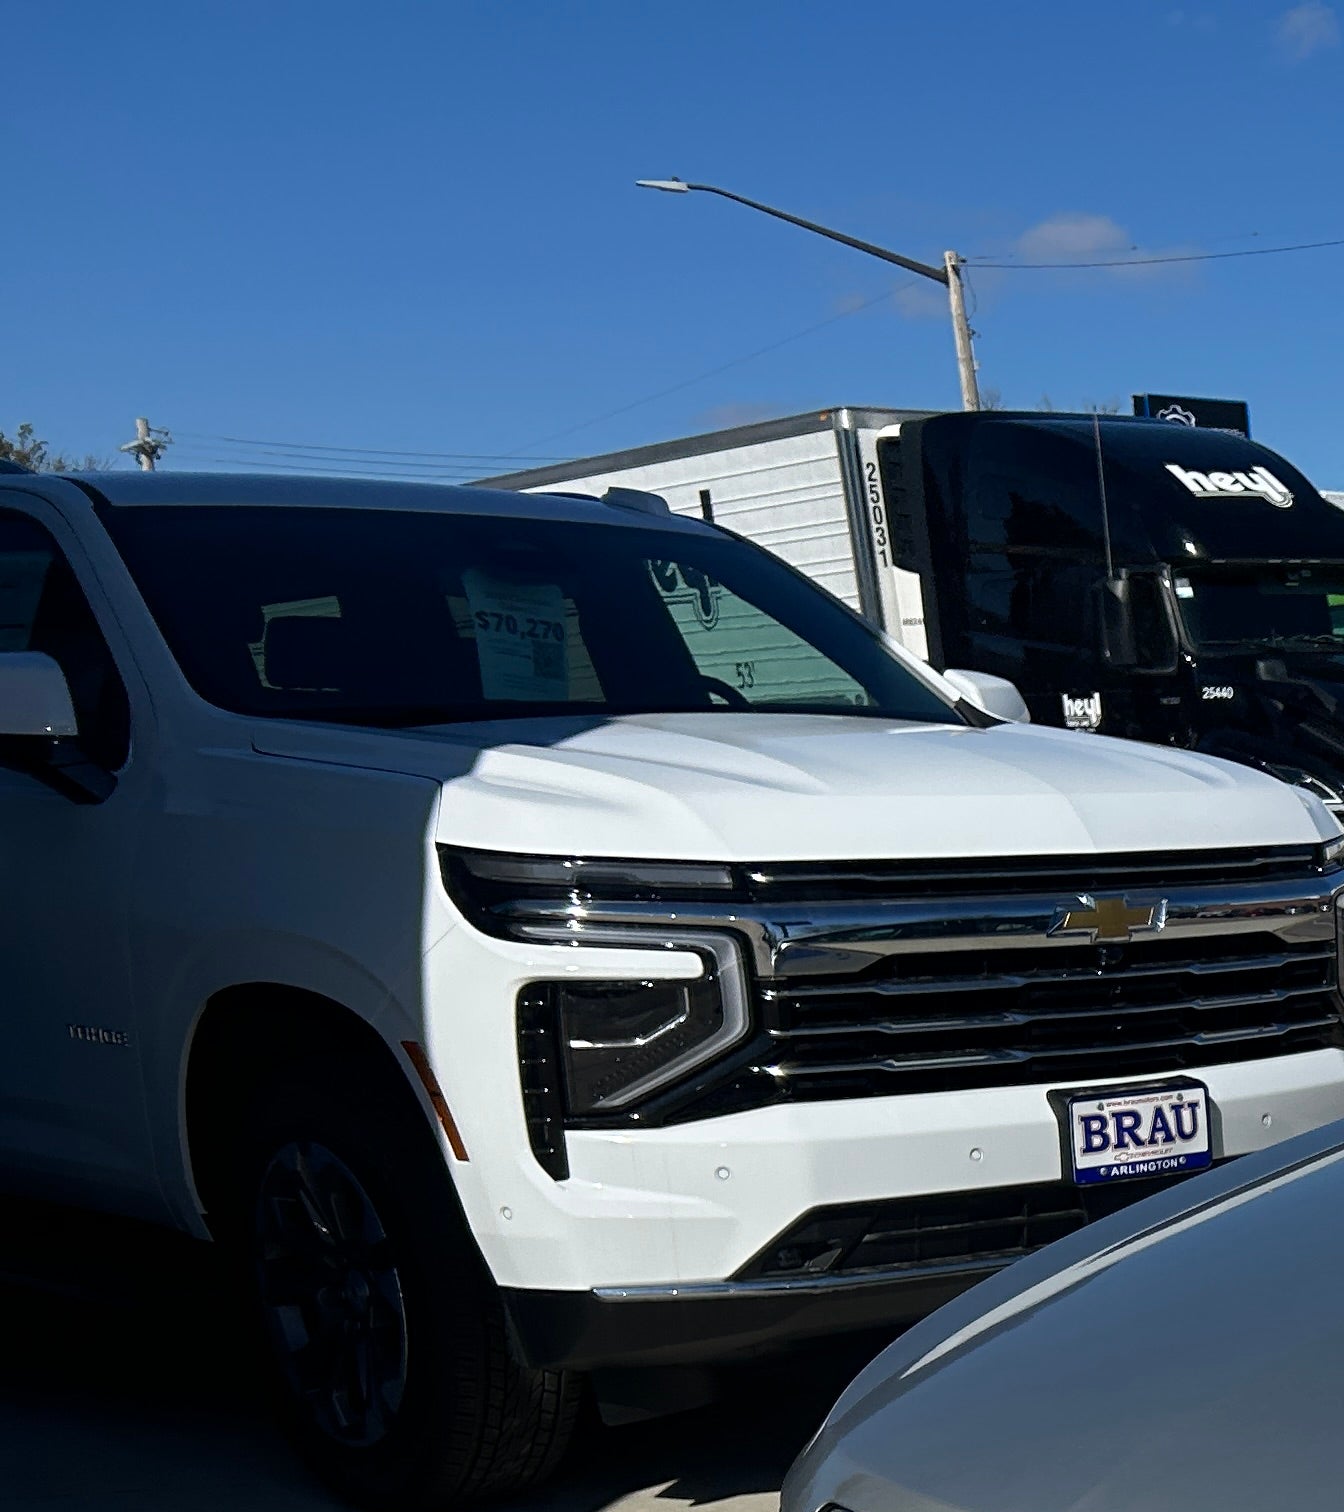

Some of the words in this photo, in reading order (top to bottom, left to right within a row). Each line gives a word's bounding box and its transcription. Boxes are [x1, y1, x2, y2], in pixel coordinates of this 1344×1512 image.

[1163, 463, 1294, 508] heyl
[865, 462, 889, 568] 25031
[1062, 692, 1102, 728] heyl
[1202, 686, 1234, 700] 25440
[1078, 1102, 1200, 1156] BRAU
[1110, 1157, 1178, 1177] ARLINGTON
